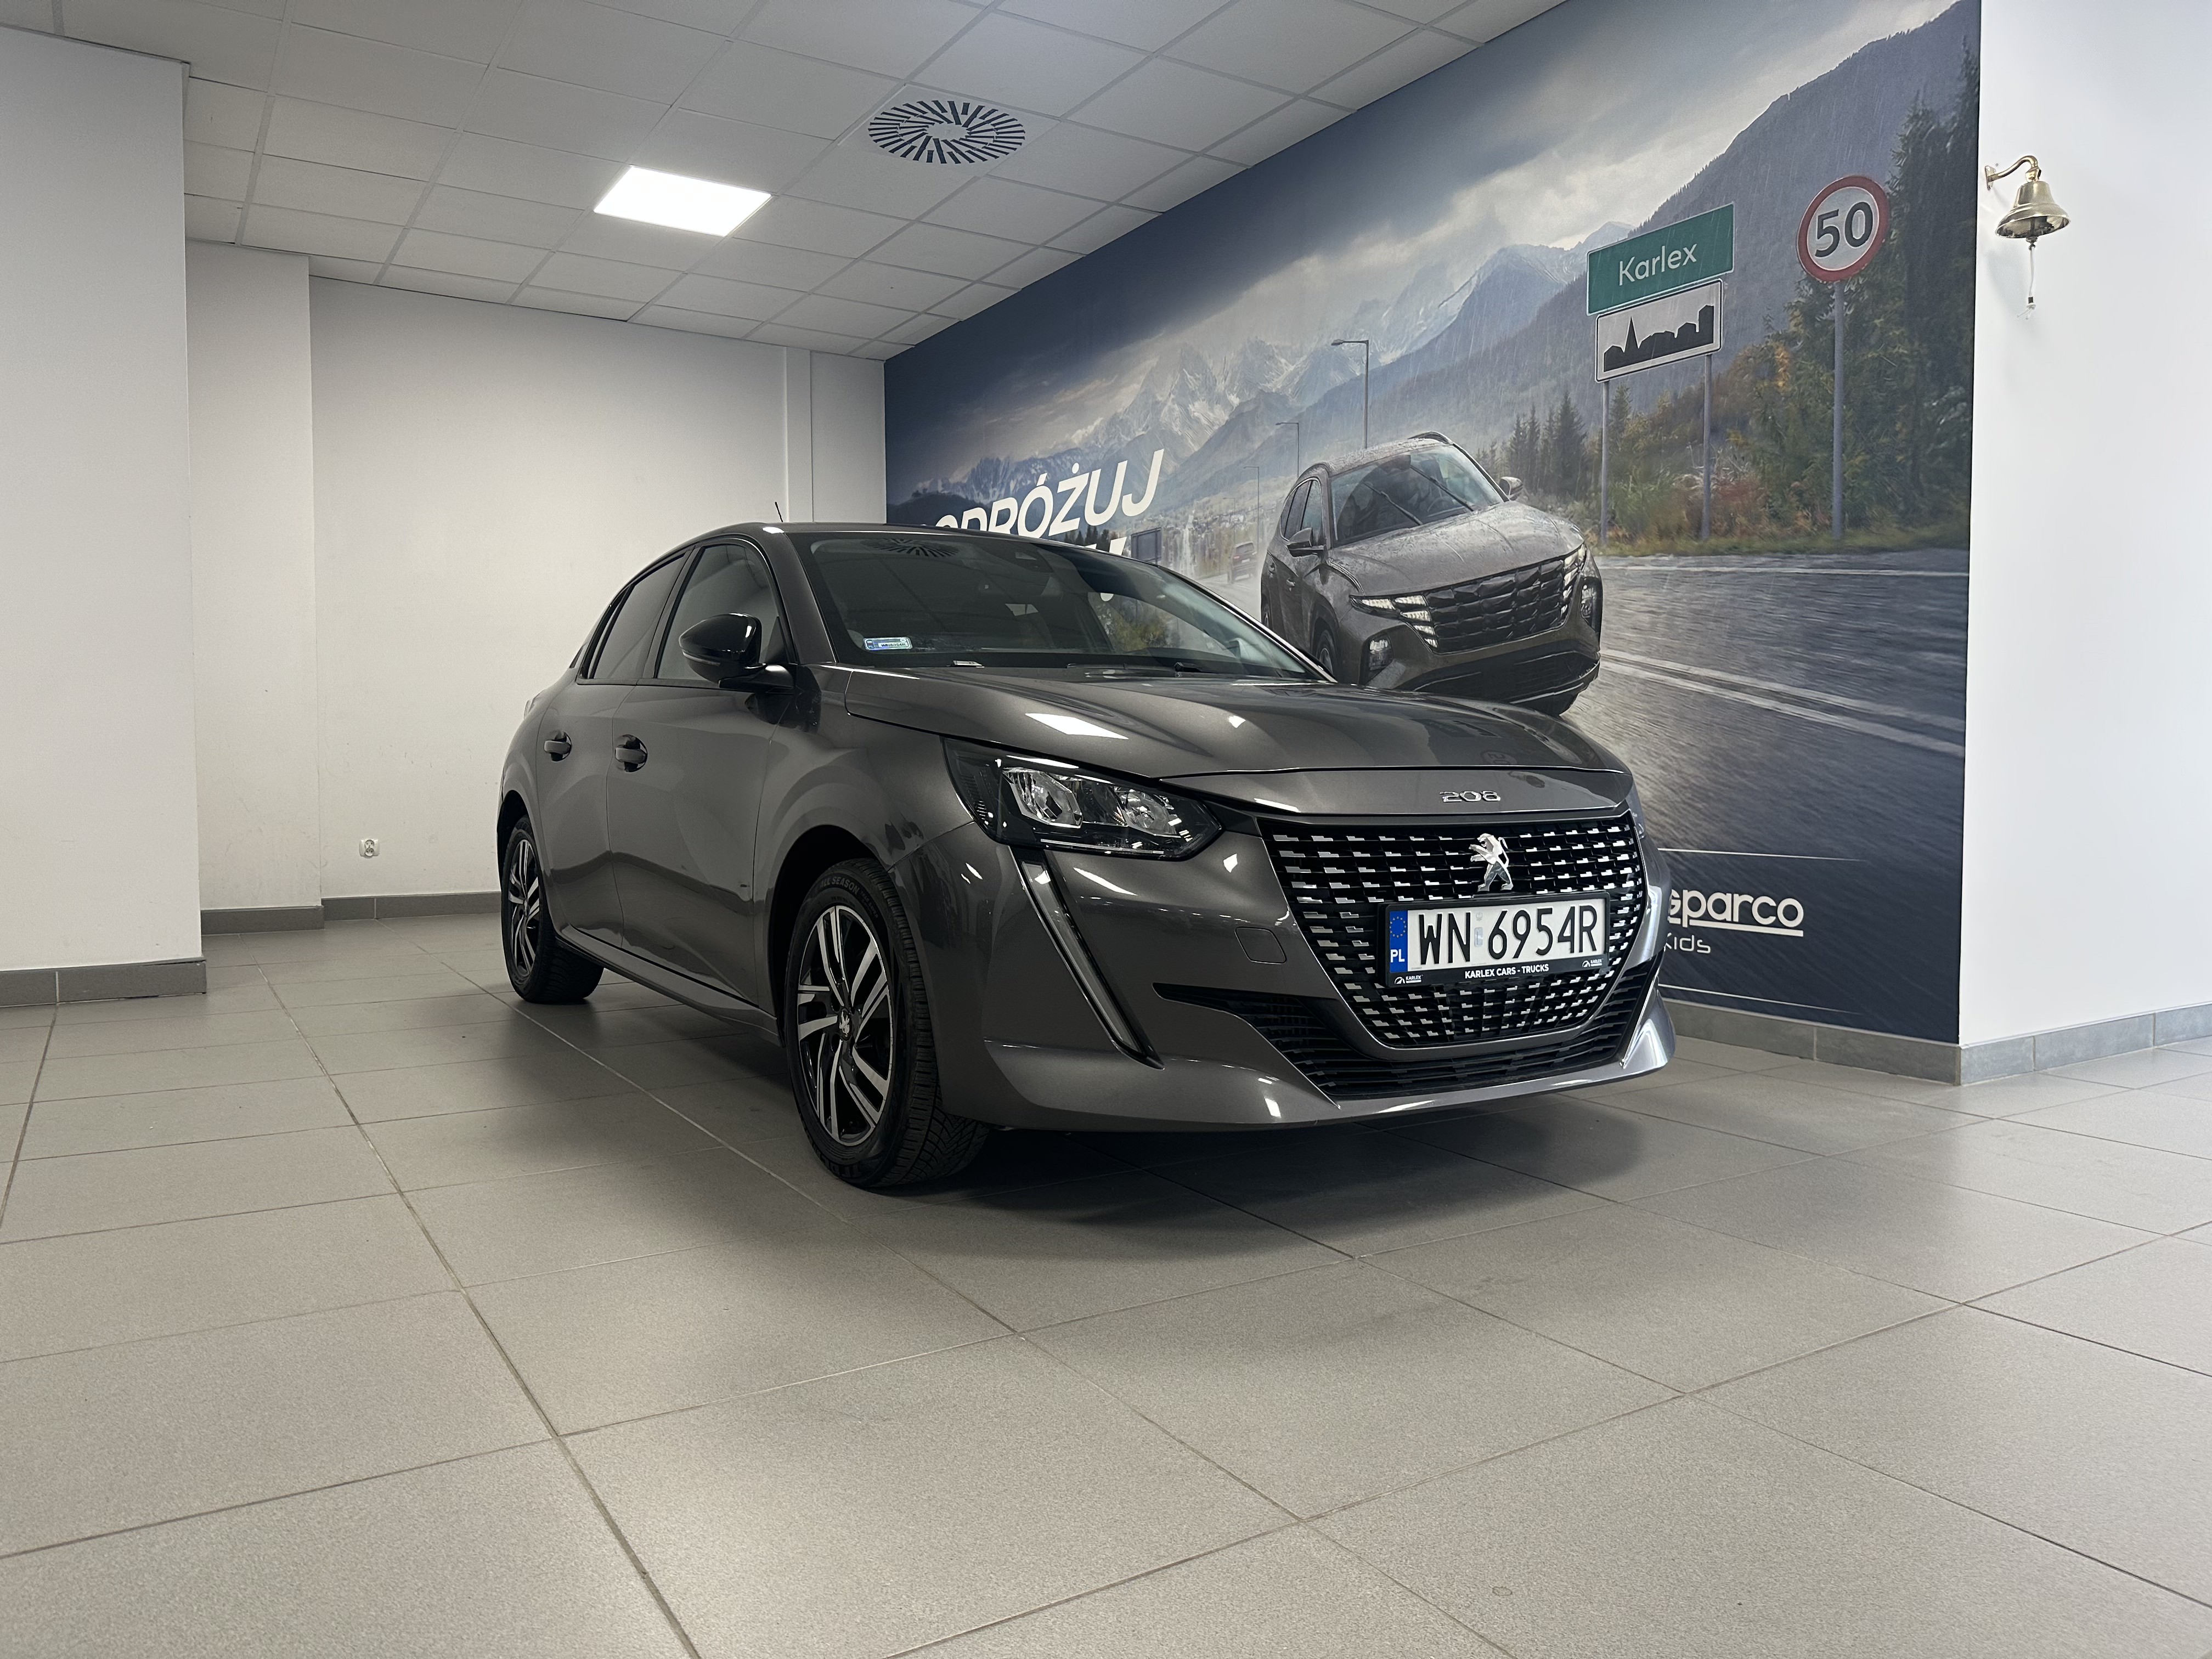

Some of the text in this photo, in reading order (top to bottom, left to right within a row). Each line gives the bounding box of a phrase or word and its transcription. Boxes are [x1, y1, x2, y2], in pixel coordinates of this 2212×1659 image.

[1814, 201, 1873, 258] 50
[1618, 243, 1697, 286] Karlex
[921, 448, 1164, 539] RÓŻUJ
[1439, 791, 1501, 803] 208
[831, 876, 860, 895] SEASON
[1419, 905, 1598, 965] WN 6954R
[1390, 949, 1405, 963] PL
[1464, 969, 1495, 979] KARLEX
[1496, 967, 1516, 977] CARS
[1521, 963, 1549, 974] TRUCKS
